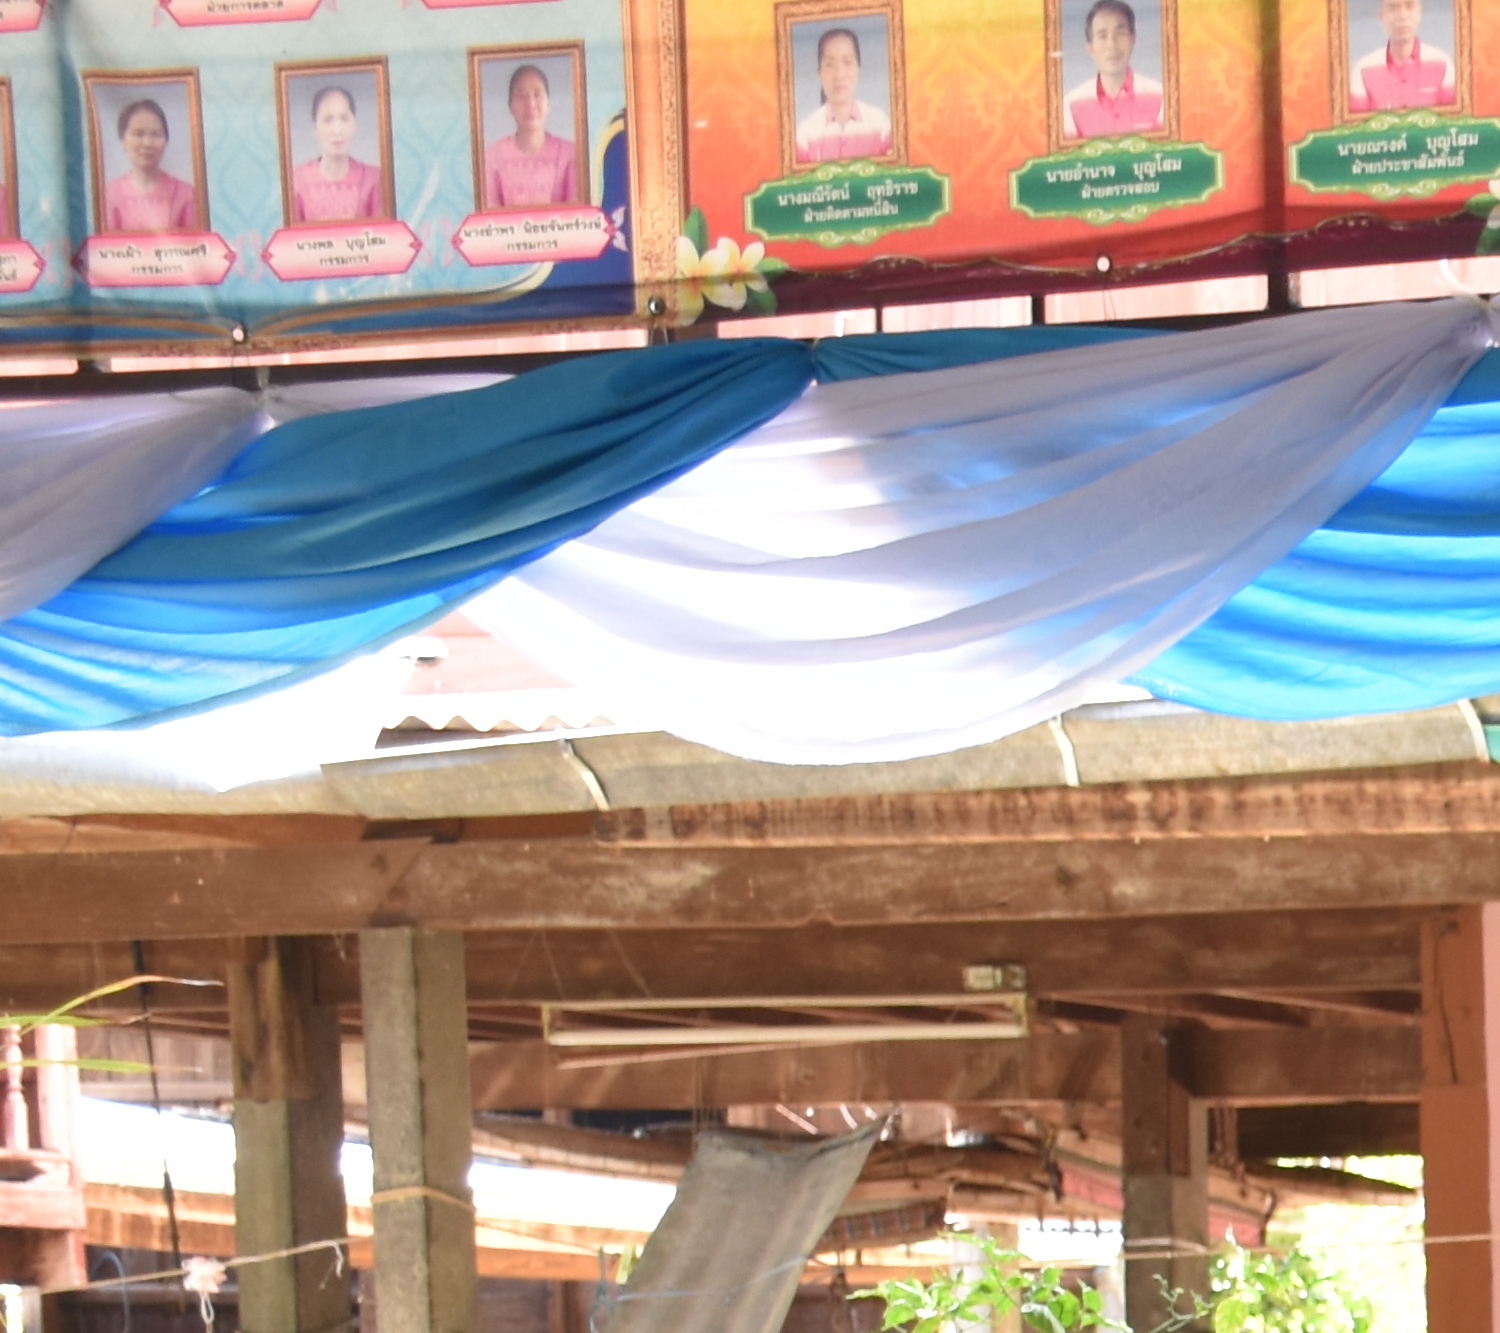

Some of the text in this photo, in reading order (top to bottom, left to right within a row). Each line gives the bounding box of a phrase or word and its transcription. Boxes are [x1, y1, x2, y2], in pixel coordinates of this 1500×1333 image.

[506, 239, 559, 252] กรรมการ
[319, 254, 370, 266] กรรมการ
[131, 264, 183, 276] กรรมการ
